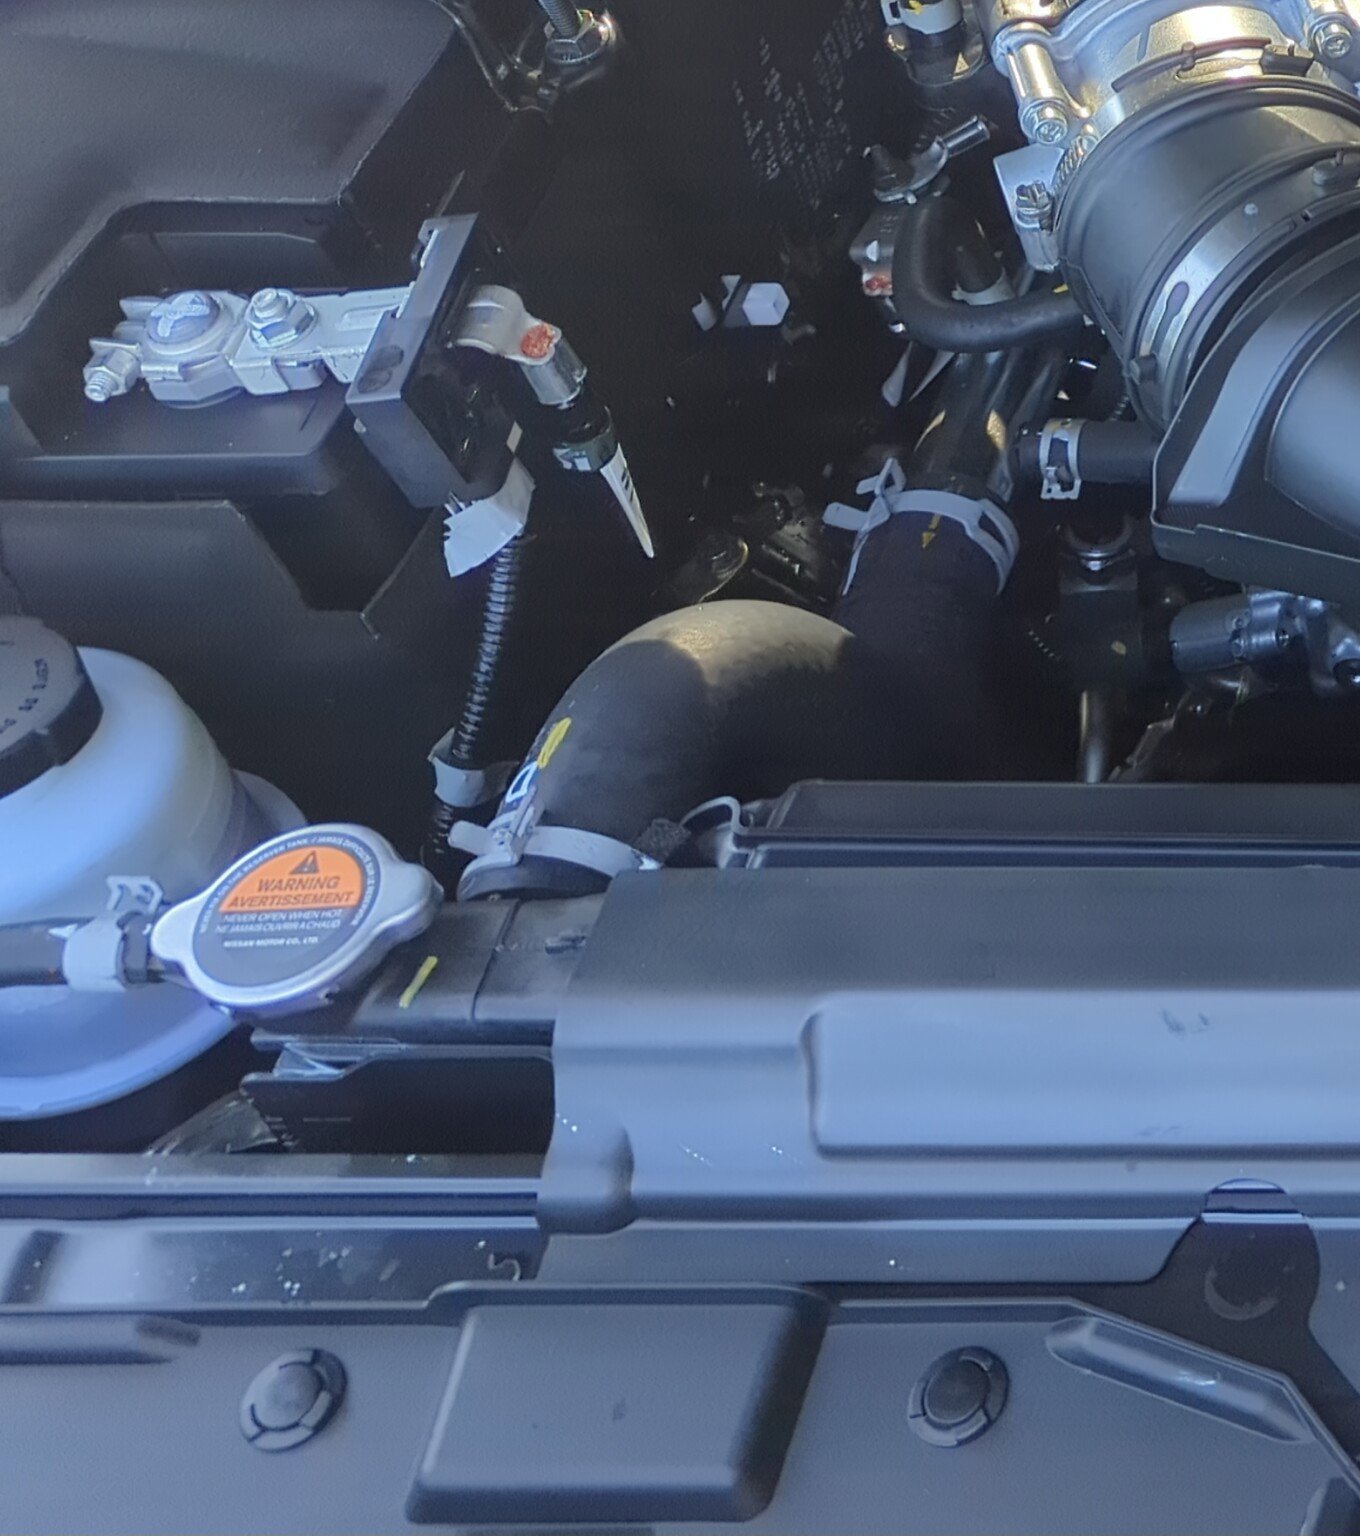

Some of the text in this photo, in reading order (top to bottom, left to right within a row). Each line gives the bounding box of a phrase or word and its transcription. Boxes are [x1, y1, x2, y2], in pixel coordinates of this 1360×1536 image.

[257, 875, 341, 892] WARNING
[228, 892, 355, 908] AVERTISSEMENT
[223, 911, 258, 923] NEVER
[258, 911, 287, 922] OPEN
[288, 909, 320, 921] WHEN
[306, 918, 341, 931] CHAUD
[222, 939, 256, 948] NISSAN
[256, 938, 286, 947] MOTOR
